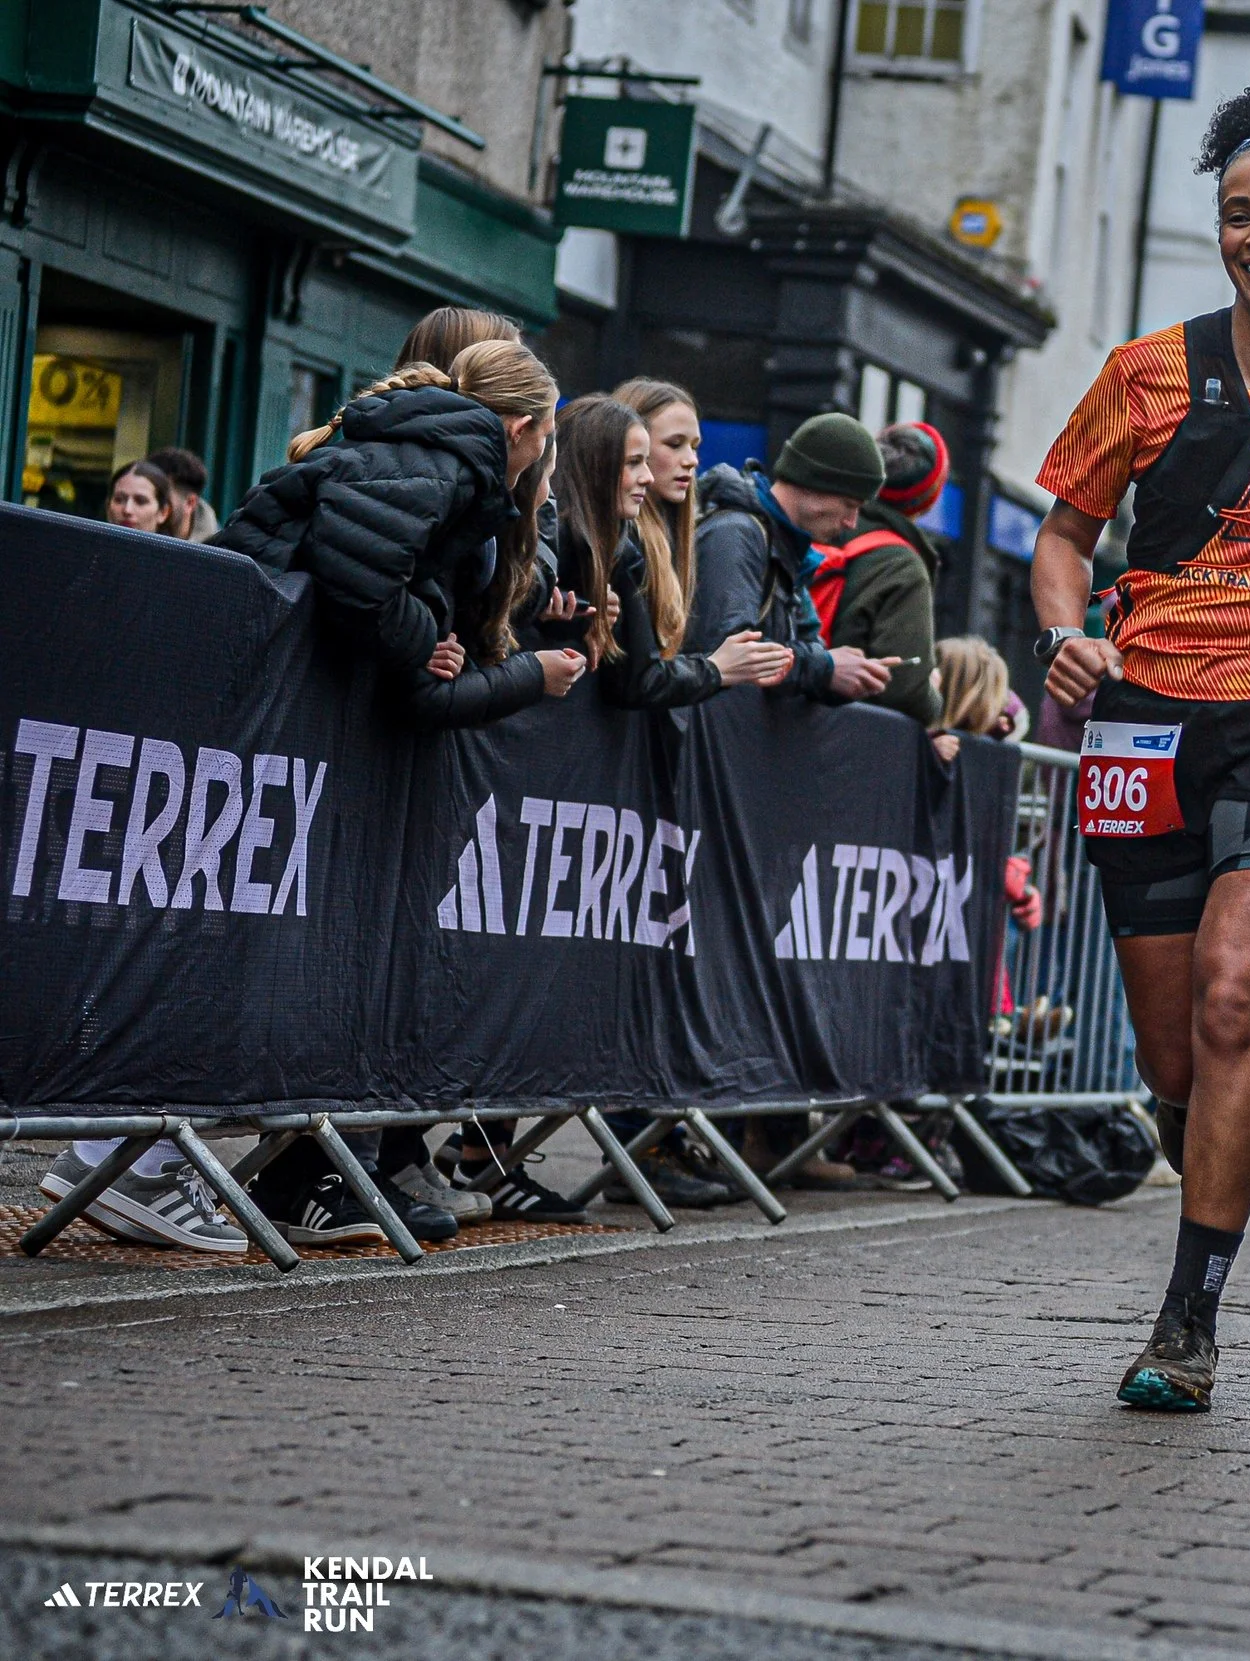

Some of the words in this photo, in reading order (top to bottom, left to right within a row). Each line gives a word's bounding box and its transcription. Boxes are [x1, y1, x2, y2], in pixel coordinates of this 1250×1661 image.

[1142, 14, 1181, 59] G
[190, 66, 271, 132] MOUNTAIN
[1085, 765, 1148, 812] 306
[12, 718, 327, 917] TERREX
[1097, 819, 1145, 834] TERREX
